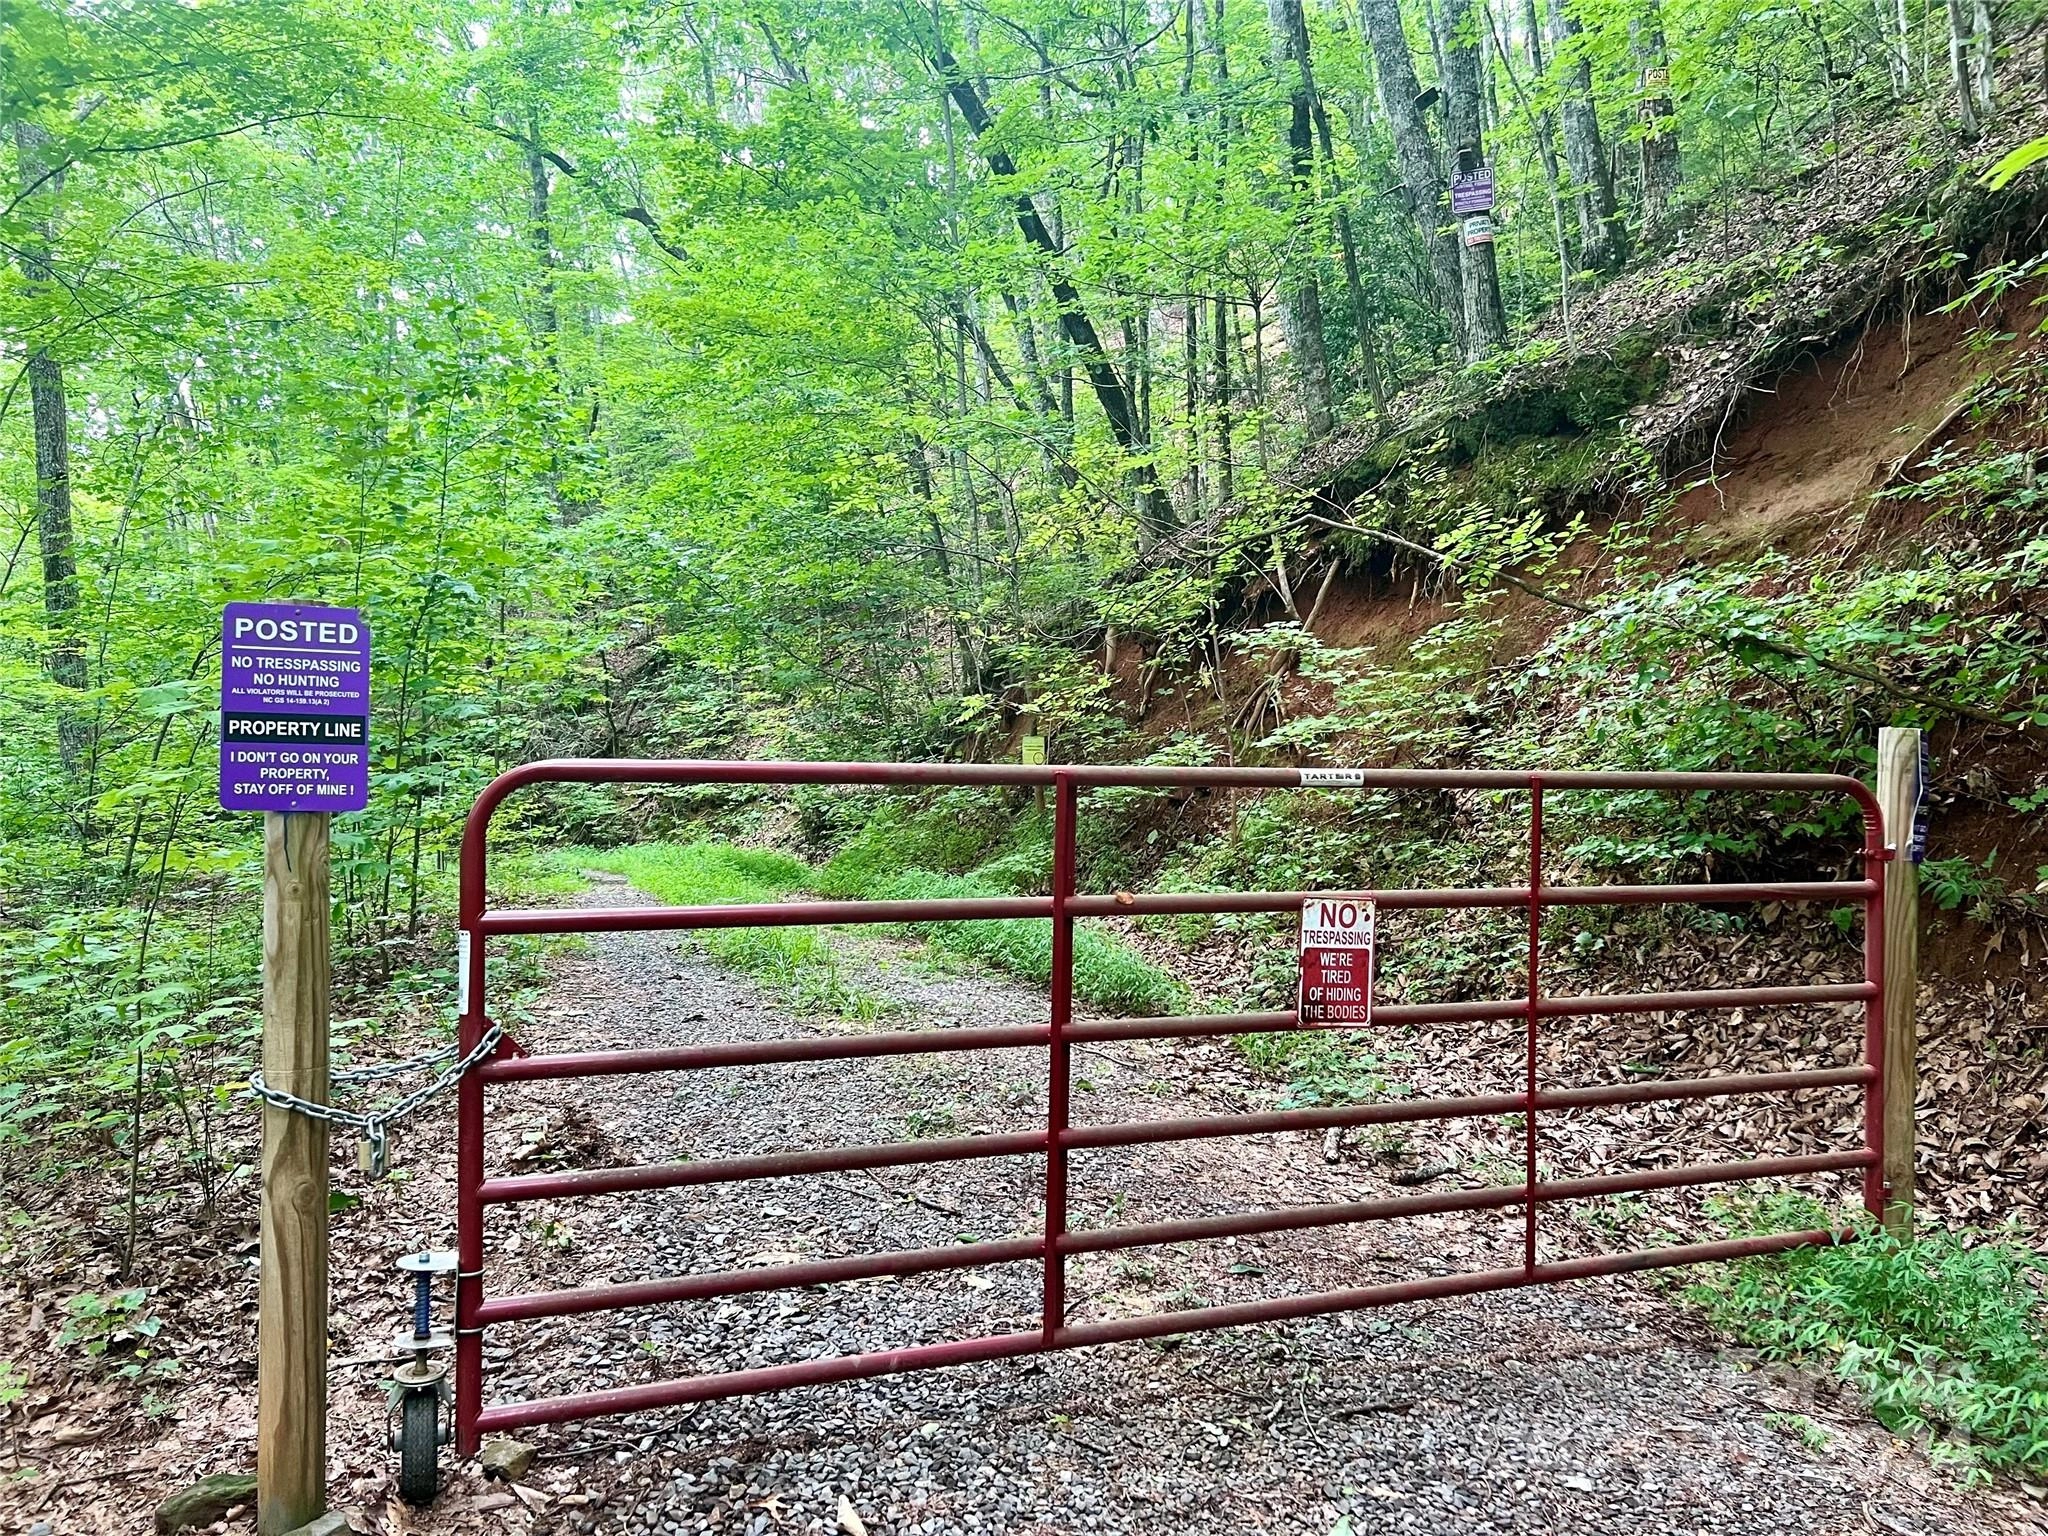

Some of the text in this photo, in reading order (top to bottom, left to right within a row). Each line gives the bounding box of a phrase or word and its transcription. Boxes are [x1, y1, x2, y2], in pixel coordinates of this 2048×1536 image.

[1647, 68, 1670, 79] POSTE
[235, 617, 359, 644] POSTED
[231, 656, 361, 672] NO TRESSPASSING
[253, 673, 340, 688] NO HUNTING
[246, 688, 285, 696] VIOLATORS
[286, 689, 303, 697] WILL
[314, 690, 360, 698] PROSECUTED
[228, 719, 361, 738] PROPERTY LINE
[230, 751, 359, 765] I DON'T GO ON YOUR
[260, 768, 330, 781] PROPERTY,
[233, 783, 266, 795] STAY
[268, 783, 293, 795] OFF
[296, 784, 314, 795] OF
[316, 784, 347, 796] MINE
[1320, 902, 1357, 929] NO
[1303, 929, 1371, 946] TRESPASSING
[1319, 952, 1353, 967] WE'RE
[1320, 969, 1352, 984] TIRED
[1309, 986, 1362, 1002] OF HIDING
[1303, 1004, 1366, 1019] THE BODIES
